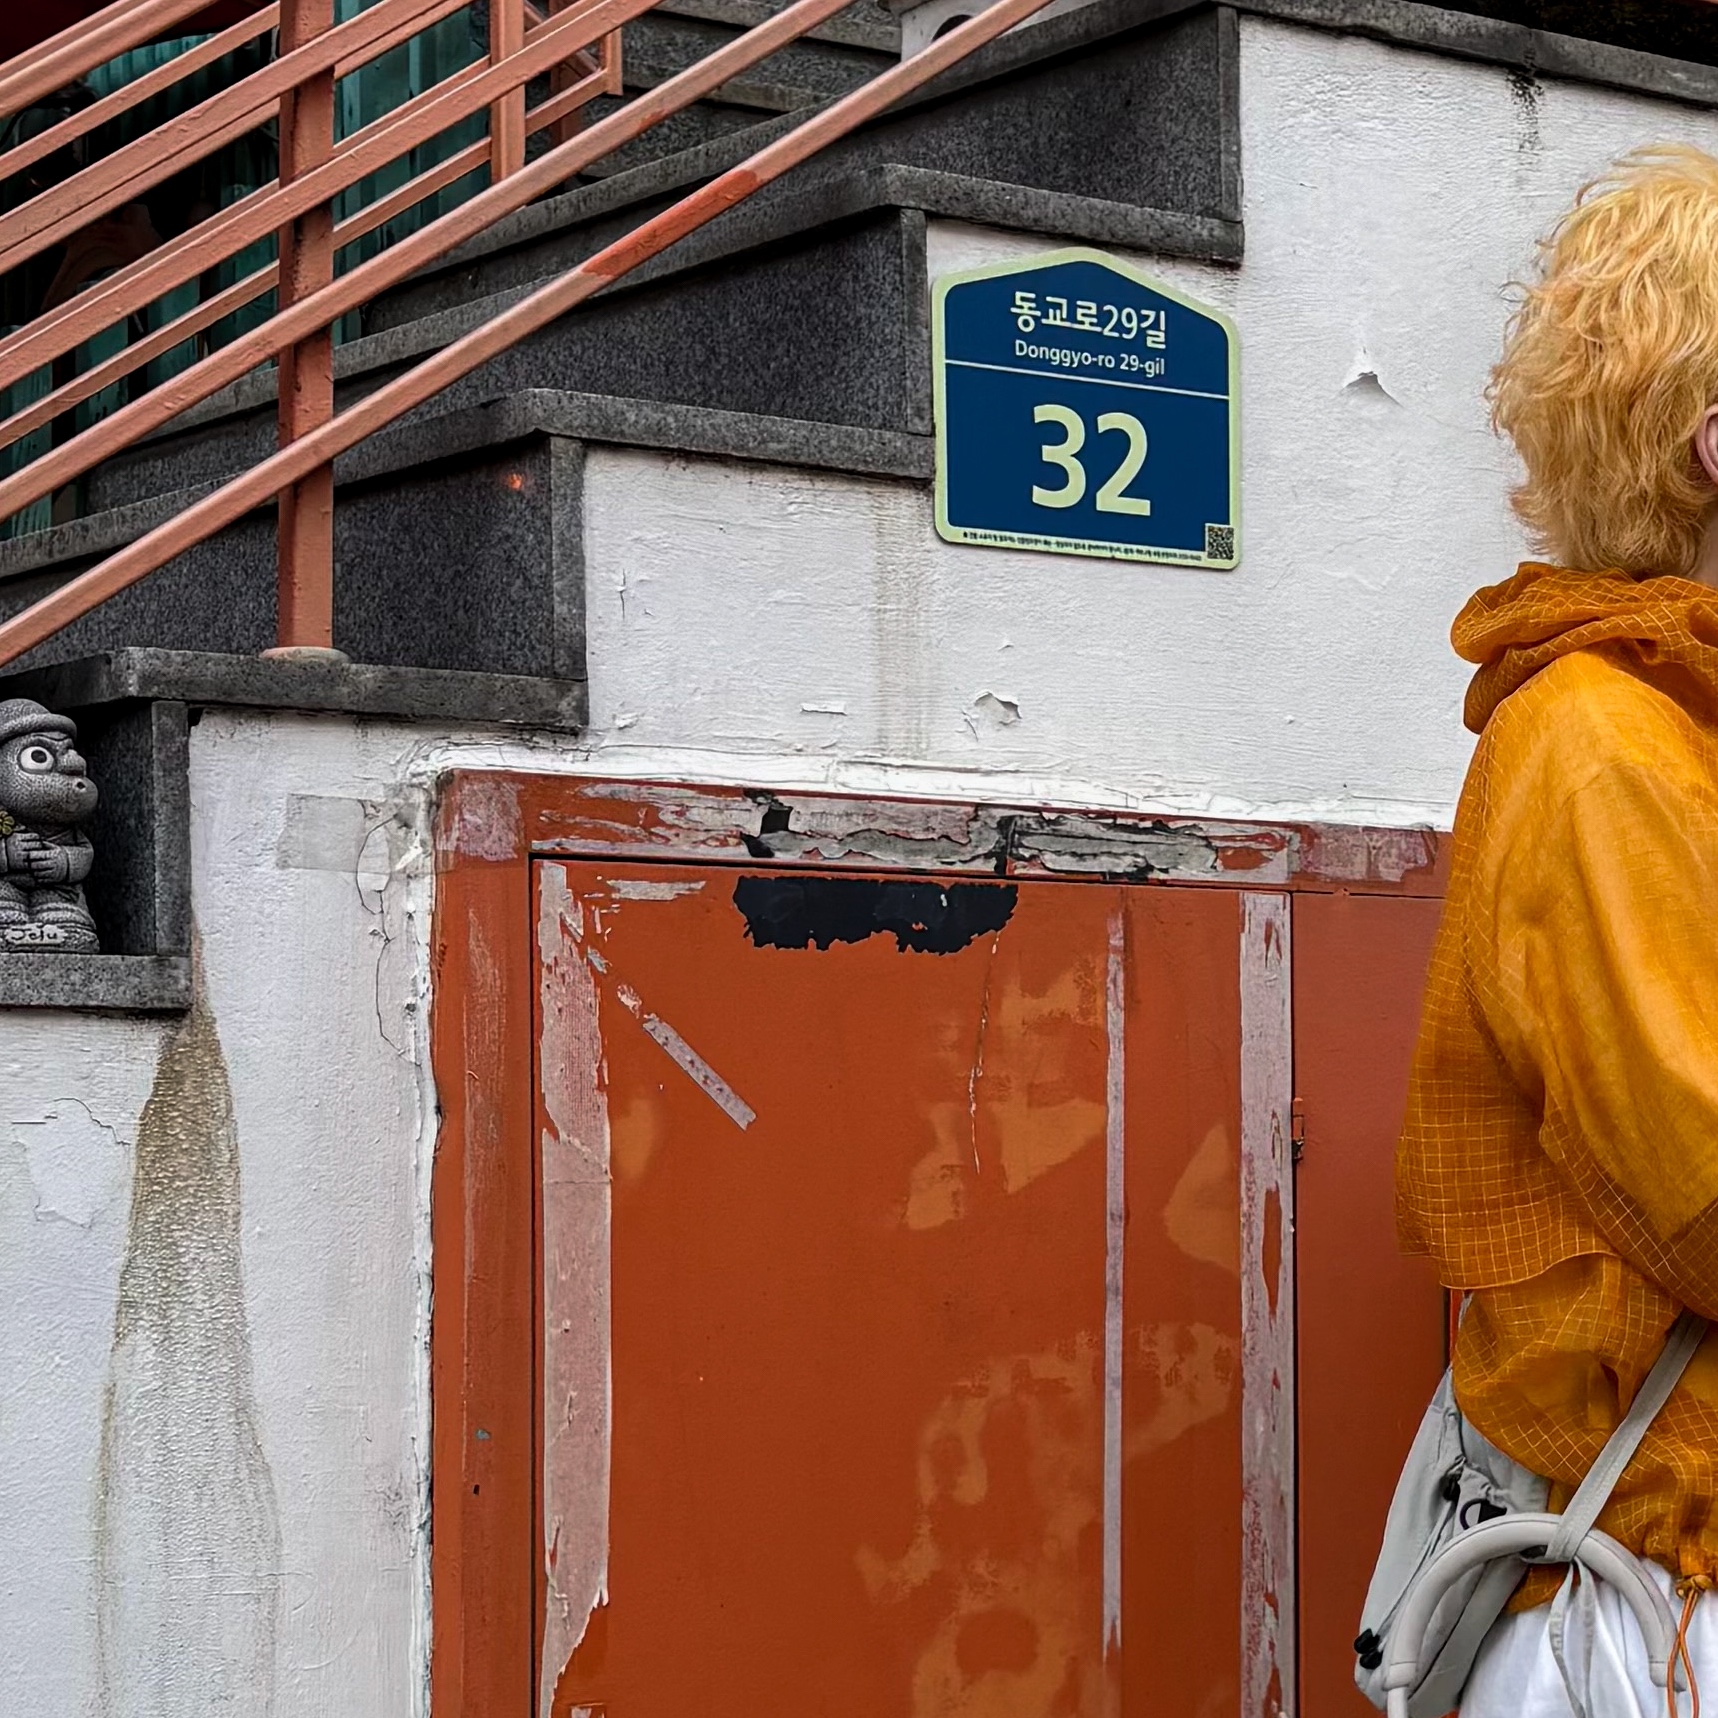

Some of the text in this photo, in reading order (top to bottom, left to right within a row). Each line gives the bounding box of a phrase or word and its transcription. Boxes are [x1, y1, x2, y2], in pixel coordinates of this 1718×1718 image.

[1010, 290, 1166, 349] 동교로29길
[1014, 340, 1165, 377] Donggyo-ro 29-gil
[1031, 403, 1151, 516] 32
